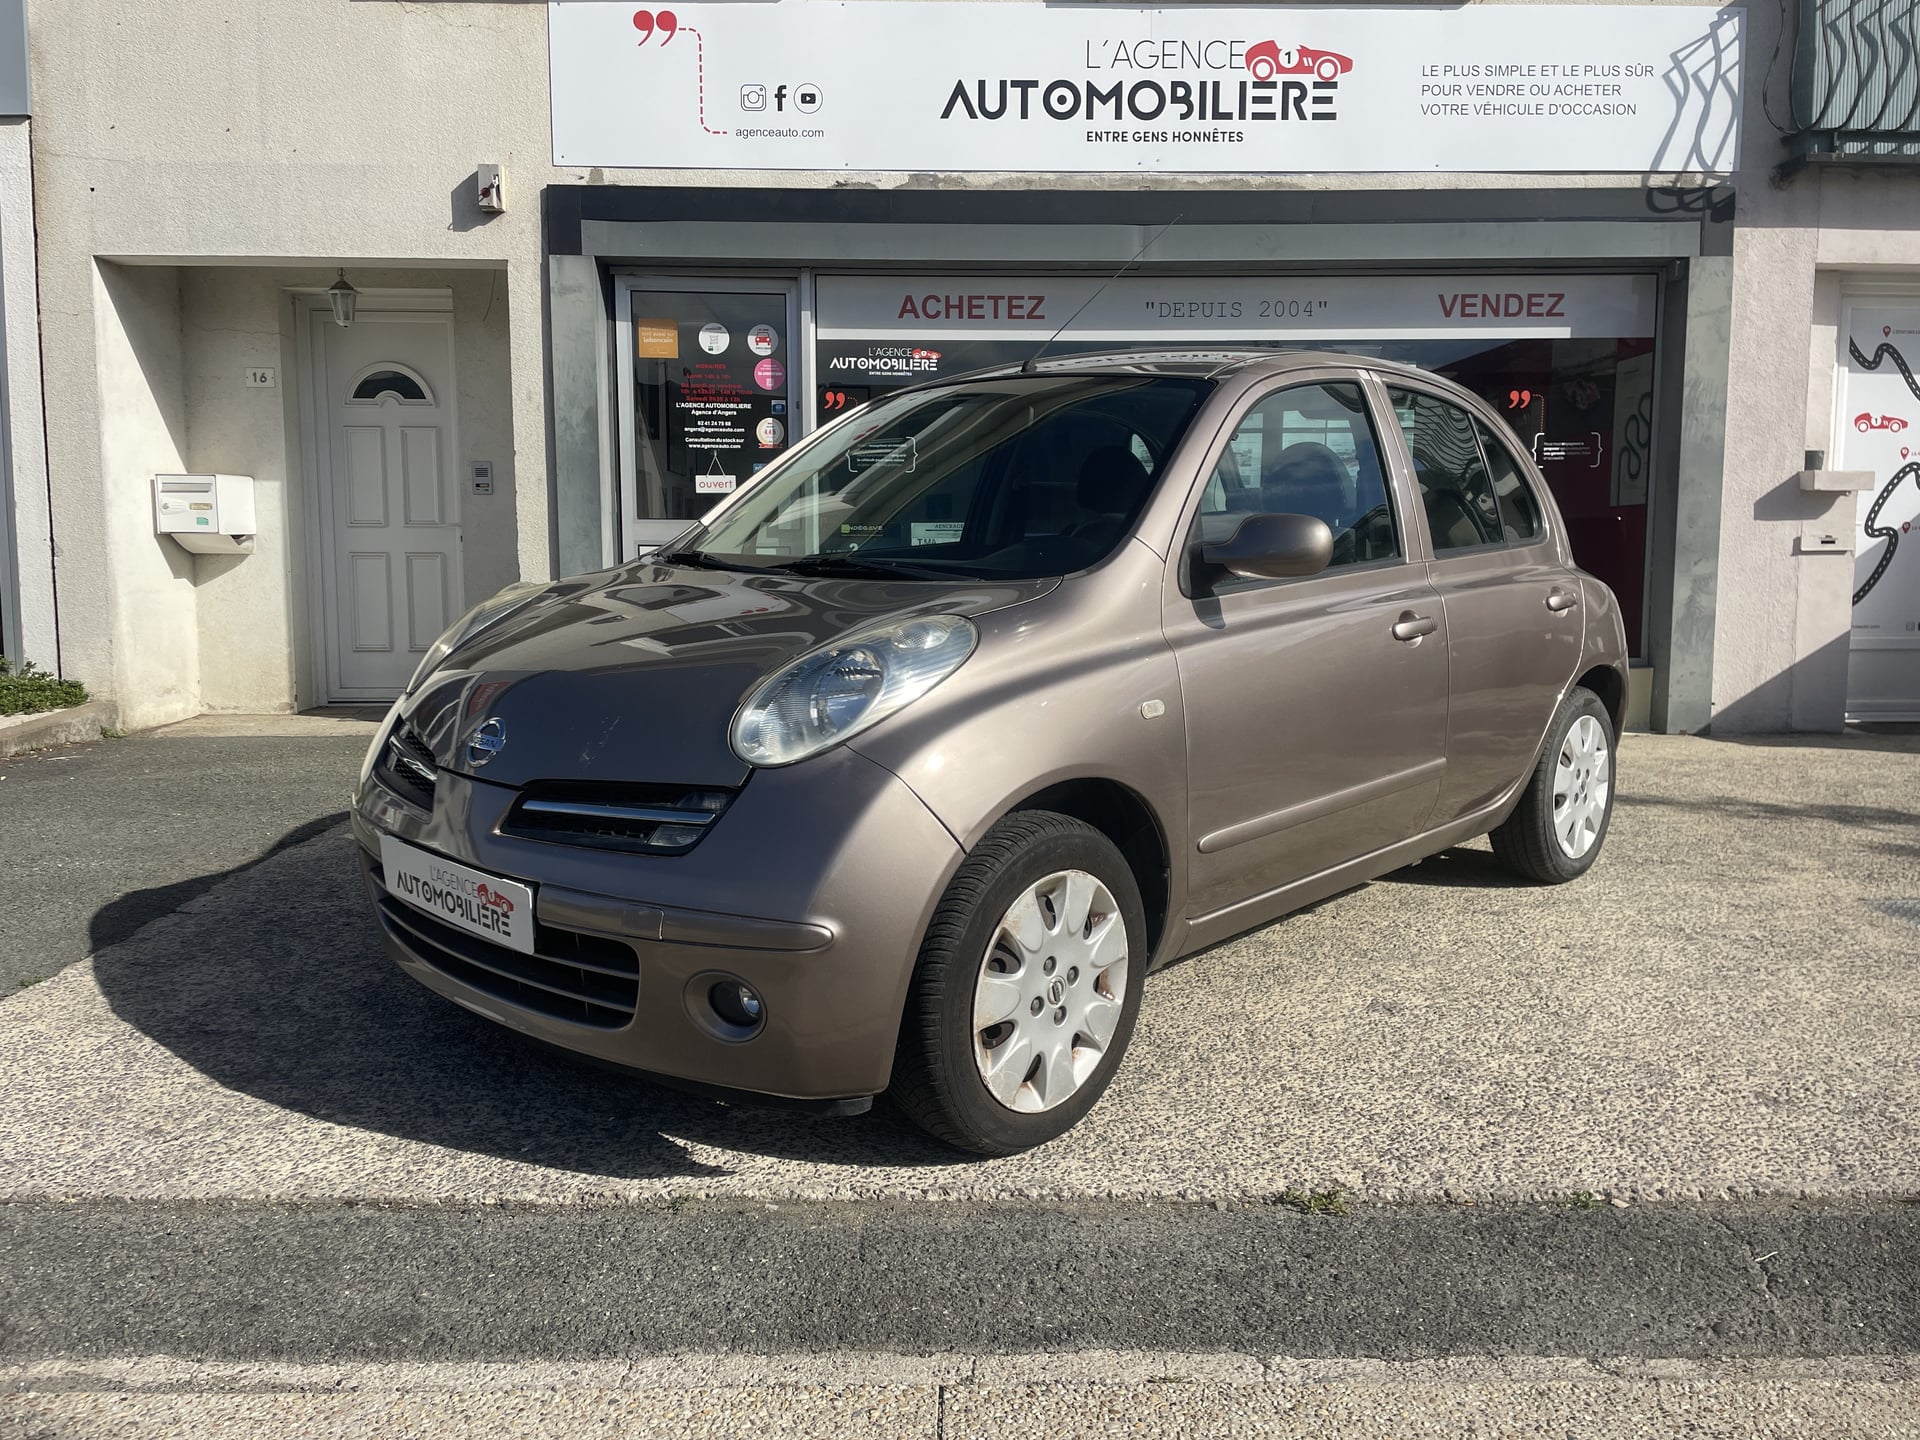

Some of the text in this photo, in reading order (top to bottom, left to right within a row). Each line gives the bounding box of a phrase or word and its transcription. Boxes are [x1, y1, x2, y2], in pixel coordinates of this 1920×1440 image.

[1086, 40, 1246, 69] L'AGENCE
[1422, 63, 1654, 77] LE PLUS SIMPLE ET LE PLUS SÛR
[1421, 84, 1621, 96] POUR VENDRE OU ACHETER
[1421, 102, 1637, 115] VOTRE VÉHICULE D'OCCASION
[735, 127, 824, 139] agenceauto.com
[1087, 128, 1243, 142] ENTRE GENS HONNÊTES
[898, 294, 1046, 319] ACHETEZ
[1145, 301, 1328, 318] "DEPUIS 2004"
[1438, 293, 1565, 317] VENDEZ
[868, 347, 912, 357] L'AGENCE
[252, 372, 267, 384] 16
[699, 479, 733, 489] ouvert
[430, 864, 479, 899] L'AGENCE
